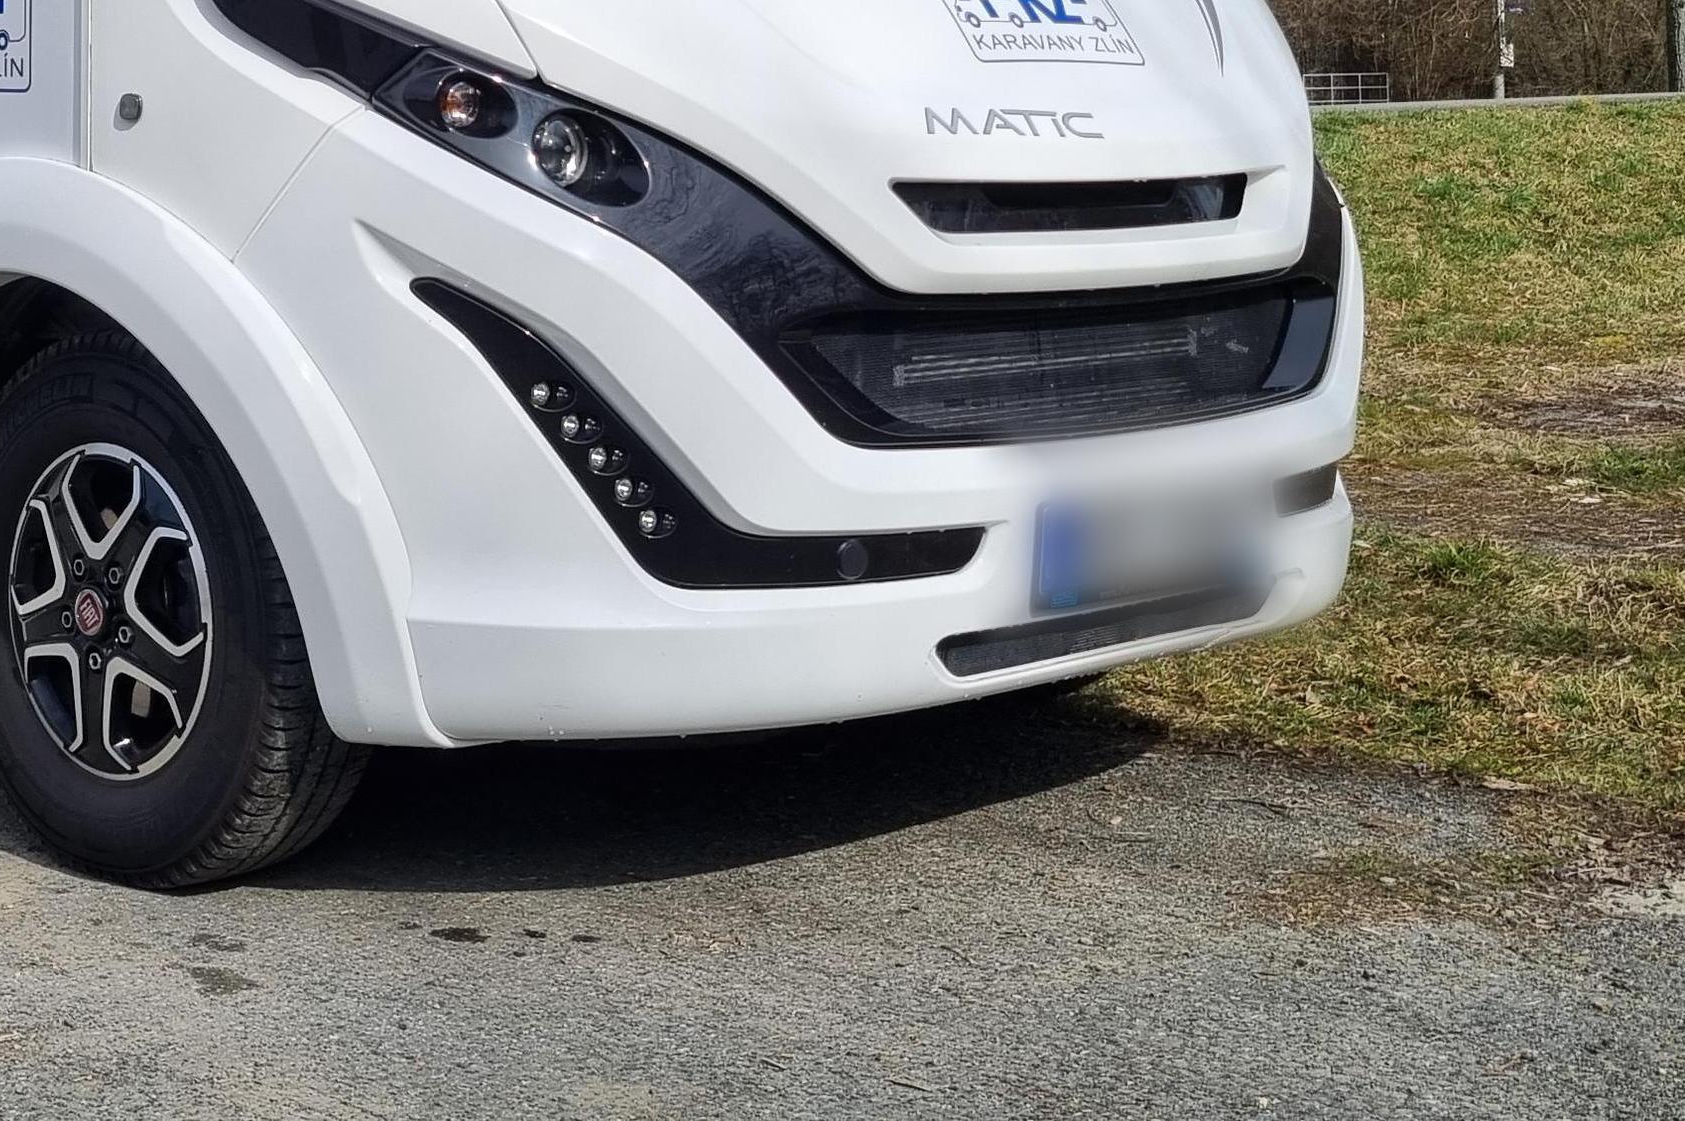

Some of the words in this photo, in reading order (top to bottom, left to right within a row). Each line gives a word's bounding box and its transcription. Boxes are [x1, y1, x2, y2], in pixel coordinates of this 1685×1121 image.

[972, 33, 1086, 53] KARAVANY
[1092, 33, 1135, 55] ZLÍN
[79, 598, 99, 629] FIAT
